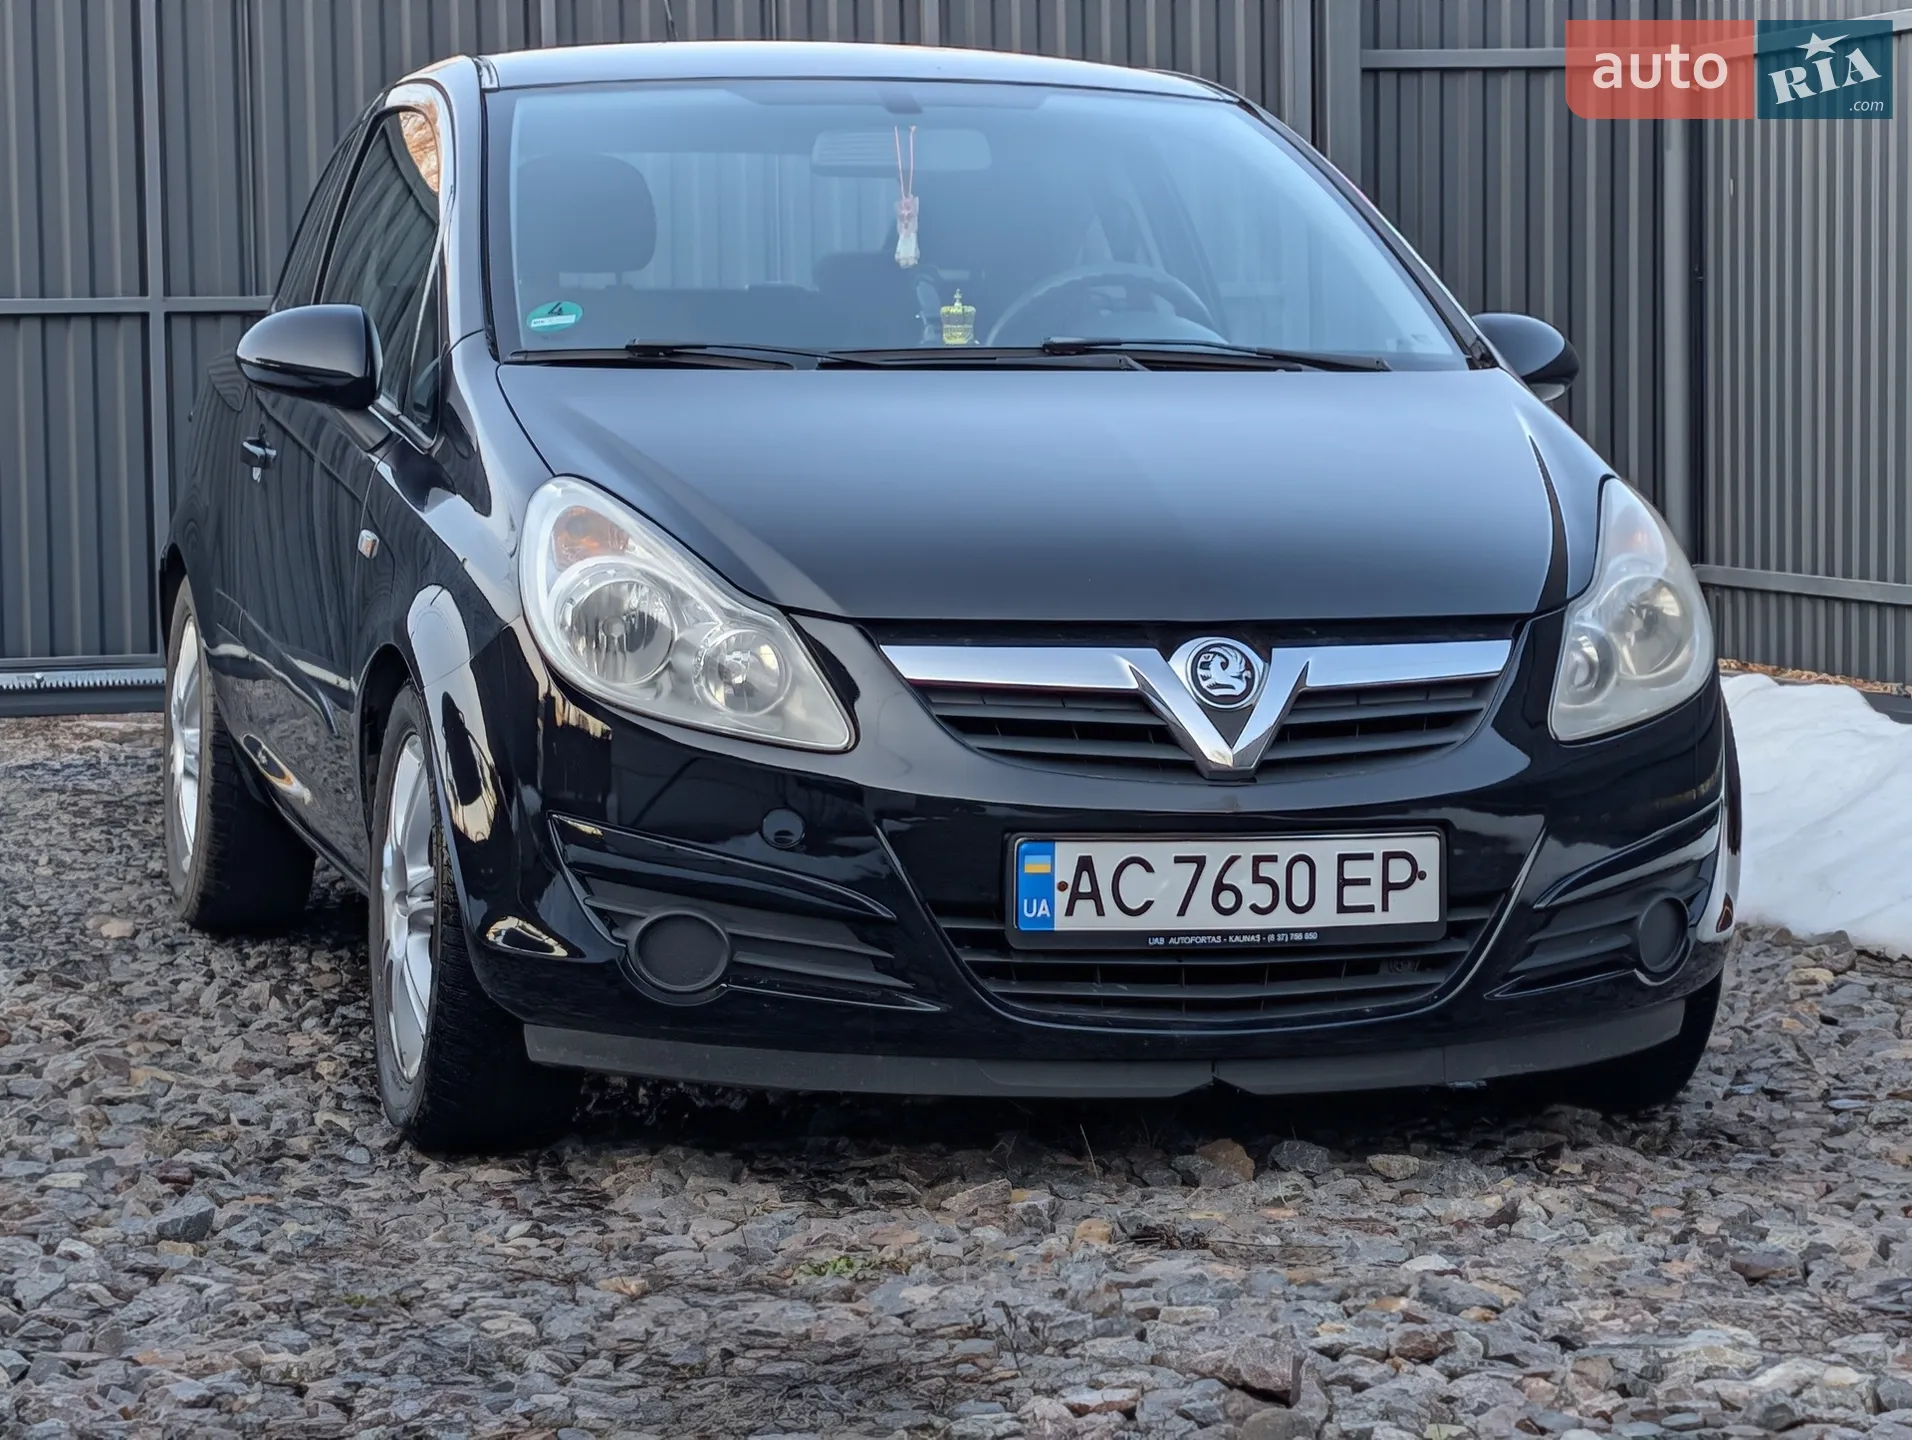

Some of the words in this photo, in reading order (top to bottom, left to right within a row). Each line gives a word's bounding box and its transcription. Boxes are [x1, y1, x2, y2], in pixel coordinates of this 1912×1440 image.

[1064, 854, 1155, 917] AC
[1173, 853, 1317, 917] 7650
[1335, 850, 1419, 914] EP
[1023, 900, 1051, 918] UA
[1148, 936, 1165, 945] UAB
[1168, 935, 1222, 945] AUTOFORTAS
[1228, 934, 1261, 943] KAUNAS
